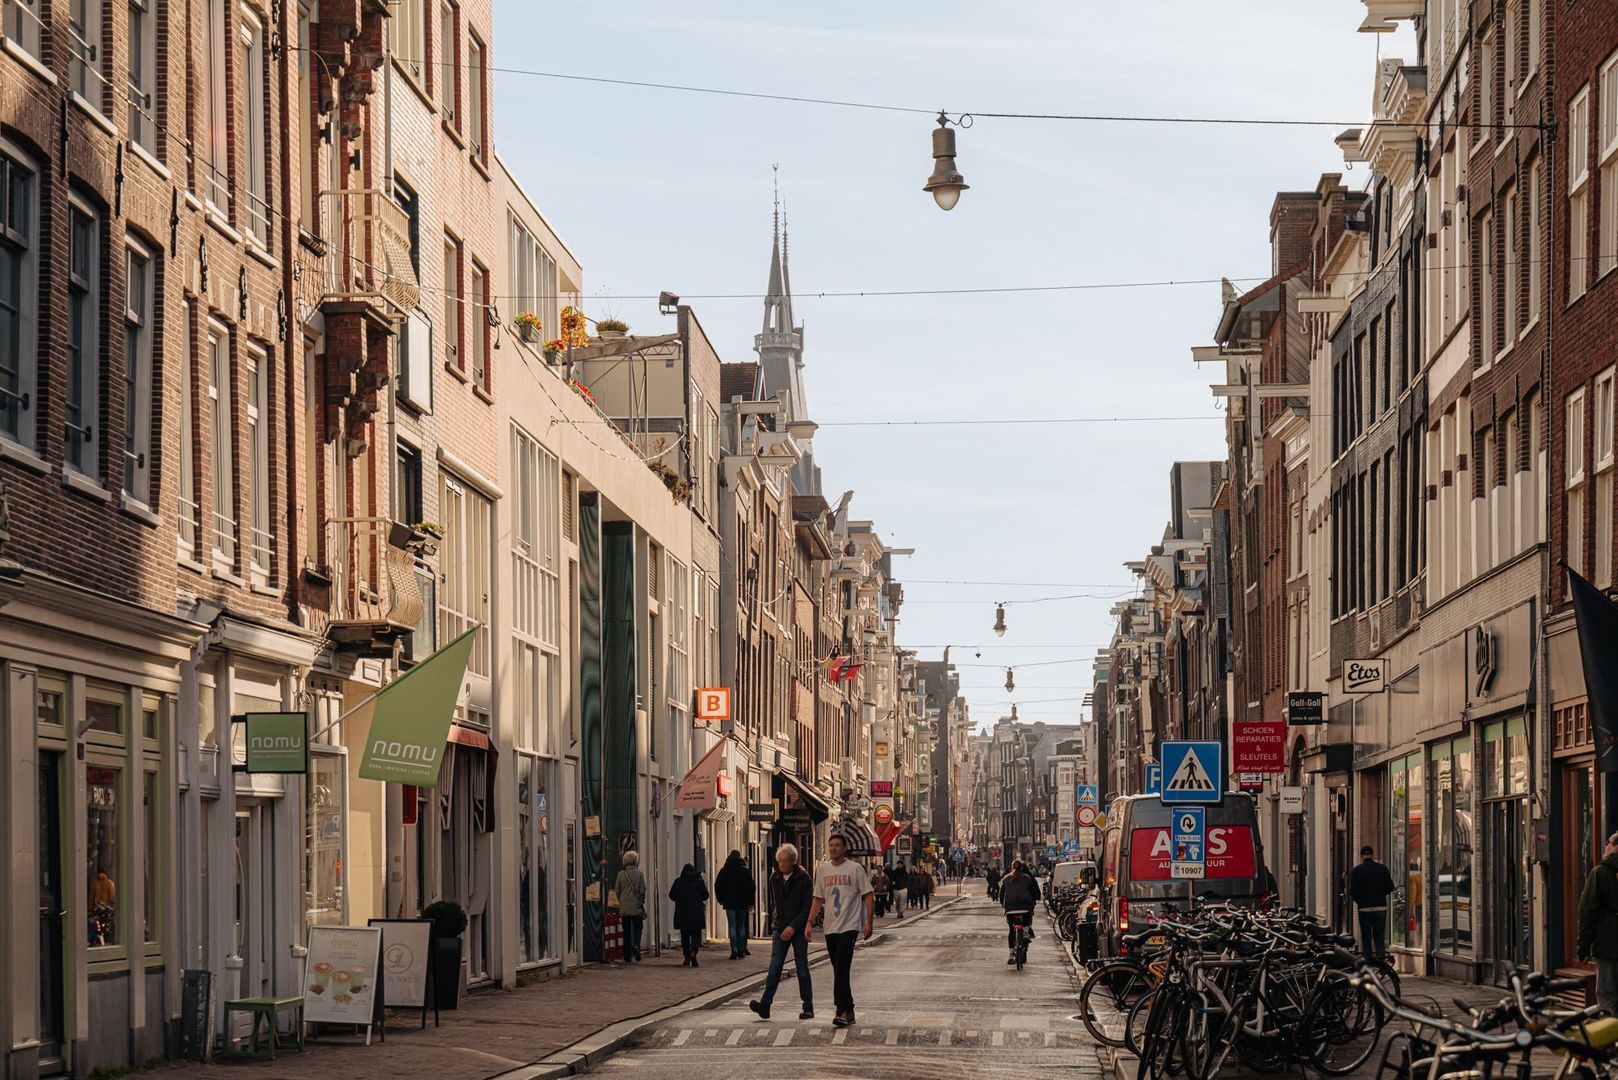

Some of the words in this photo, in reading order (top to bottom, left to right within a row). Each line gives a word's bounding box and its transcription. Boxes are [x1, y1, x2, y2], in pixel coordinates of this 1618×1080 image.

[1347, 663, 1380, 681] Etos
[706, 695, 720, 712] B
[1242, 726, 1275, 734] SCHOEN
[251, 736, 301, 748] nomu
[1235, 735, 1281, 743] REPARATIES
[372, 740, 437, 761] nomu
[1239, 753, 1278, 761] SLEUTELS
[1181, 867, 1202, 875] 10907
